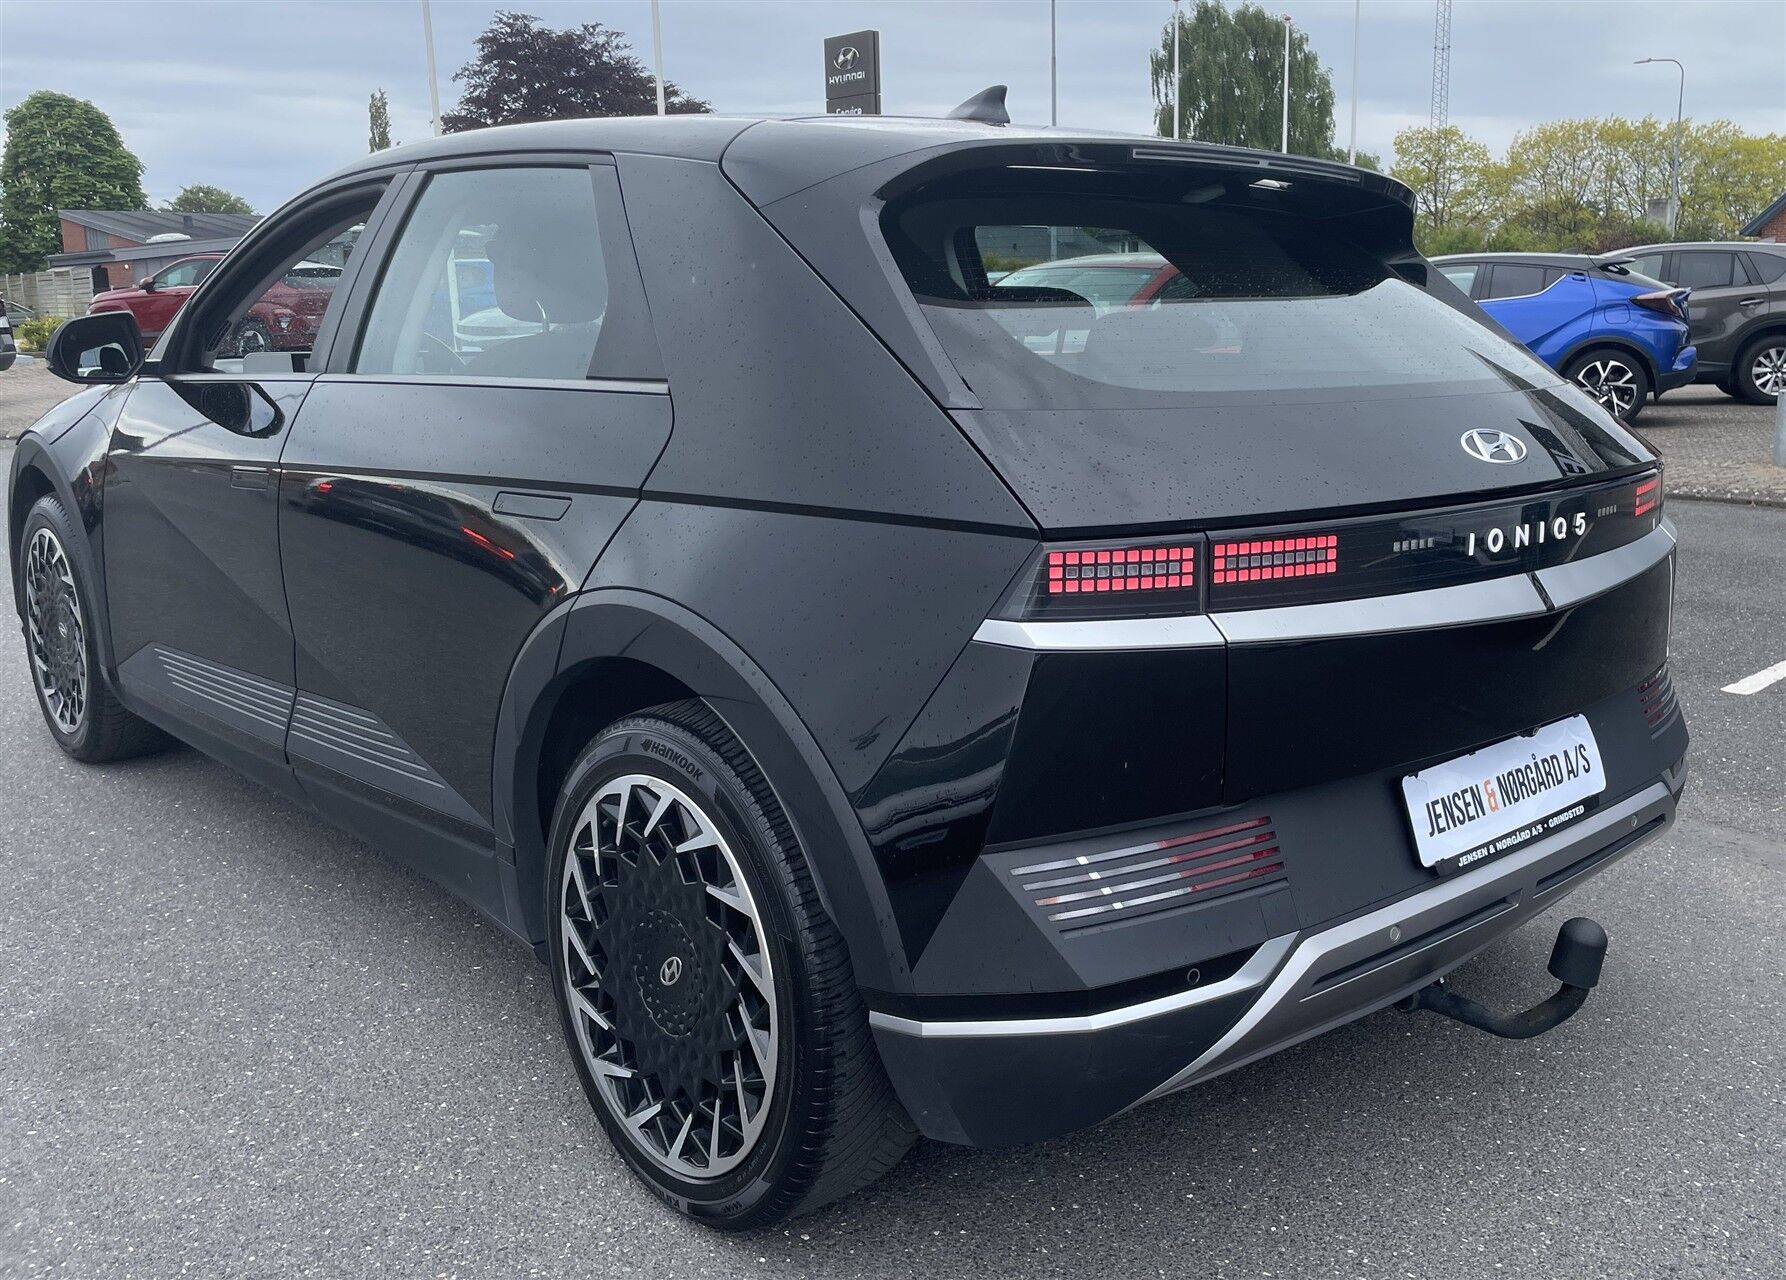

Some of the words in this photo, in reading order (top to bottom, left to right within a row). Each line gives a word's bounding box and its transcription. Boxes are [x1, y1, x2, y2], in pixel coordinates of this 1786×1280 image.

[829, 71, 865, 85] HYUNDAI
[1425, 784, 1486, 837] JENSEN
[1483, 778, 1499, 813] &
[1496, 753, 1563, 808] NØRGÅRD
[1563, 743, 1591, 781] A/S
[1458, 847, 1489, 867] JENSEN
[1489, 844, 1496, 854] &
[1496, 832, 1531, 851] NØRGÅRD
[1531, 824, 1544, 837] A/S
[1548, 805, 1585, 828] GRINDSTED
